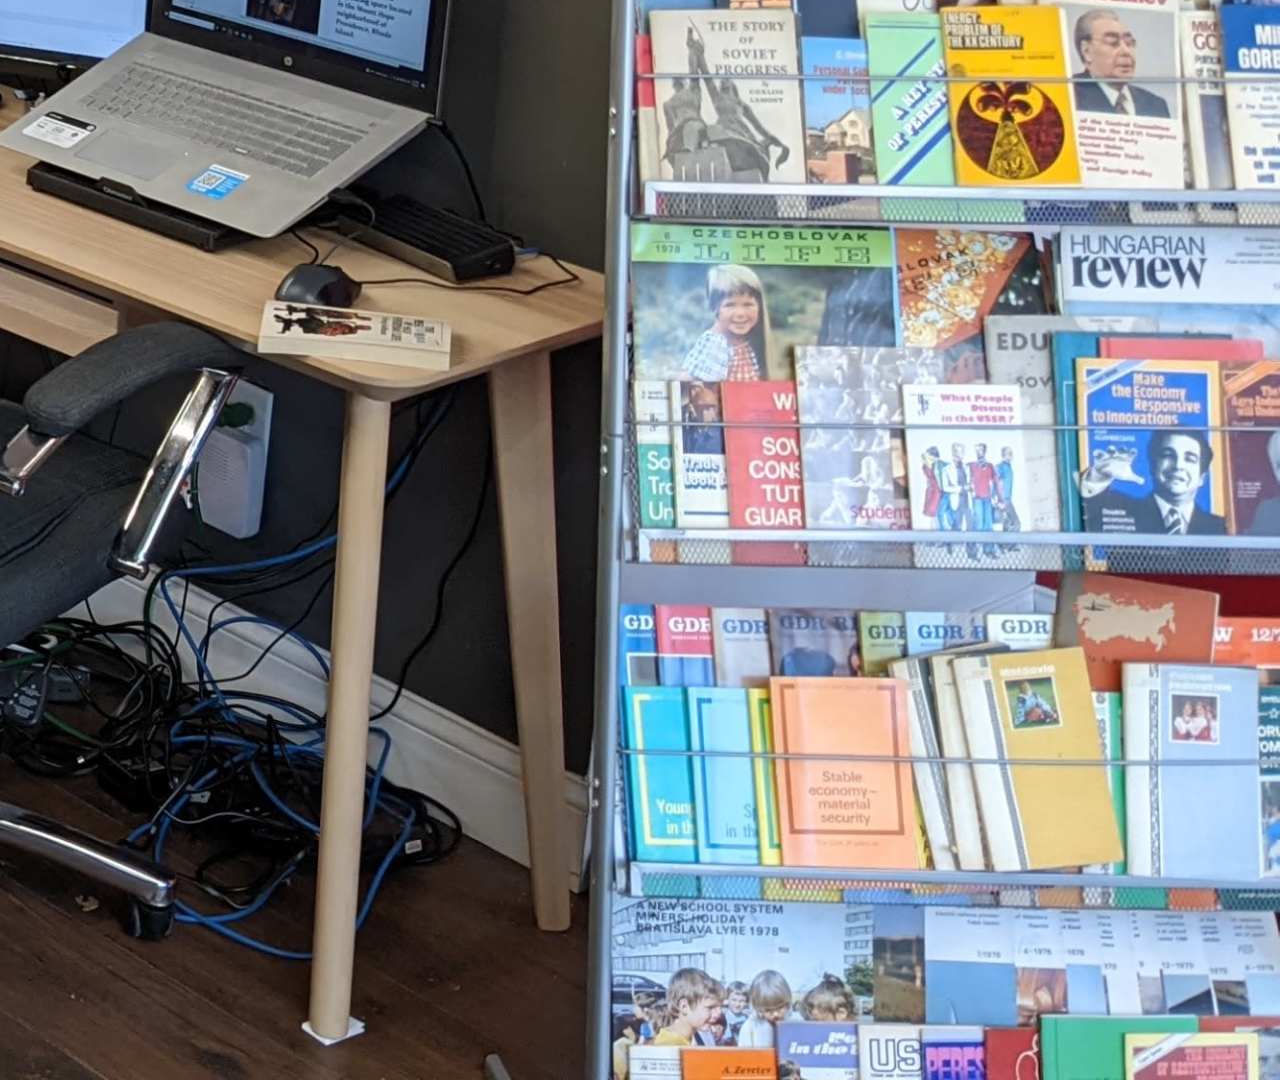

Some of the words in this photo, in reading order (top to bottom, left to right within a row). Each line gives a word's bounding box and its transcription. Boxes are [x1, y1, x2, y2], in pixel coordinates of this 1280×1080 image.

[708, 20, 737, 33] THE
[742, 21, 786, 33] STORY
[944, 22, 989, 36] PROBLEM
[739, 36, 755, 45] OF
[948, 35, 964, 49] THE
[979, 35, 1024, 50] CENTURY
[722, 49, 778, 61] SOVIET
[714, 64, 789, 76] PROGRESS
[691, 228, 869, 242] CZECHOSLOVAK
[1071, 234, 1207, 256] HUNGARIAN
[693, 242, 872, 264] LIFE
[1071, 254, 1208, 290] review
[1133, 373, 1166, 387] Make
[940, 392, 971, 402] What
[1111, 384, 1133, 398] the
[1133, 385, 1188, 402] Economy
[1134, 399, 1202, 416] Responsive
[1092, 409, 1106, 423] to
[1001, 619, 1050, 635] GDR
[822, 770, 863, 784] Stable
[818, 798, 871, 811] material
[820, 811, 871, 826] security
[647, 901, 679, 912] NEW
[680, 901, 731, 913] SCHOOL
[734, 904, 784, 915] SYSTEM
[691, 914, 746, 925] HOLIDAY
[635, 923, 713, 935] BRATISLAVA
[716, 925, 746, 936] LYRE
[749, 926, 780, 938] 1978
